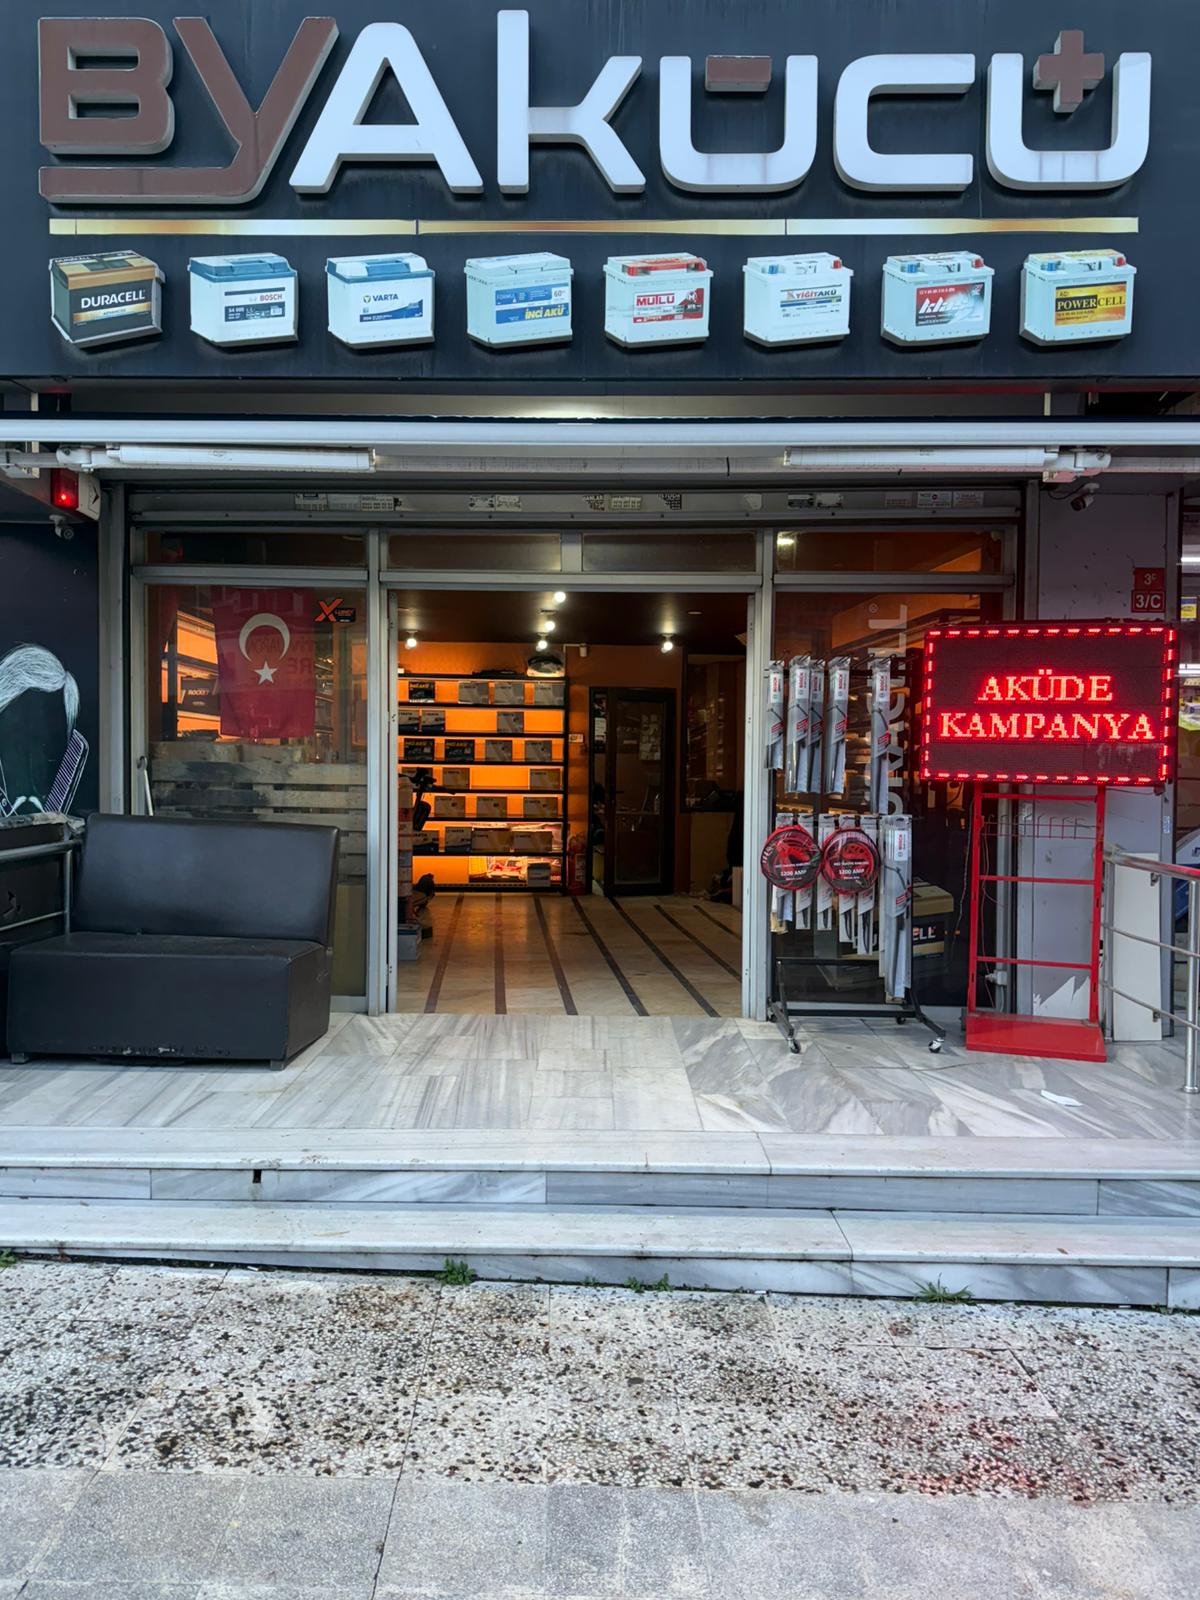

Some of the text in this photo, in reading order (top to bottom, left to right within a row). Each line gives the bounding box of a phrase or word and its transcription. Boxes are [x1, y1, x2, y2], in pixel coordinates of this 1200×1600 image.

[80, 289, 146, 309] DURACELL
[259, 293, 283, 302] BOSCH
[372, 293, 399, 302] VARTA
[544, 304, 565, 317] AKÜ
[1136, 594, 1161, 609] 3/C
[977, 668, 1114, 702] AKÜDE
[939, 712, 1156, 741] KAMPANYA
